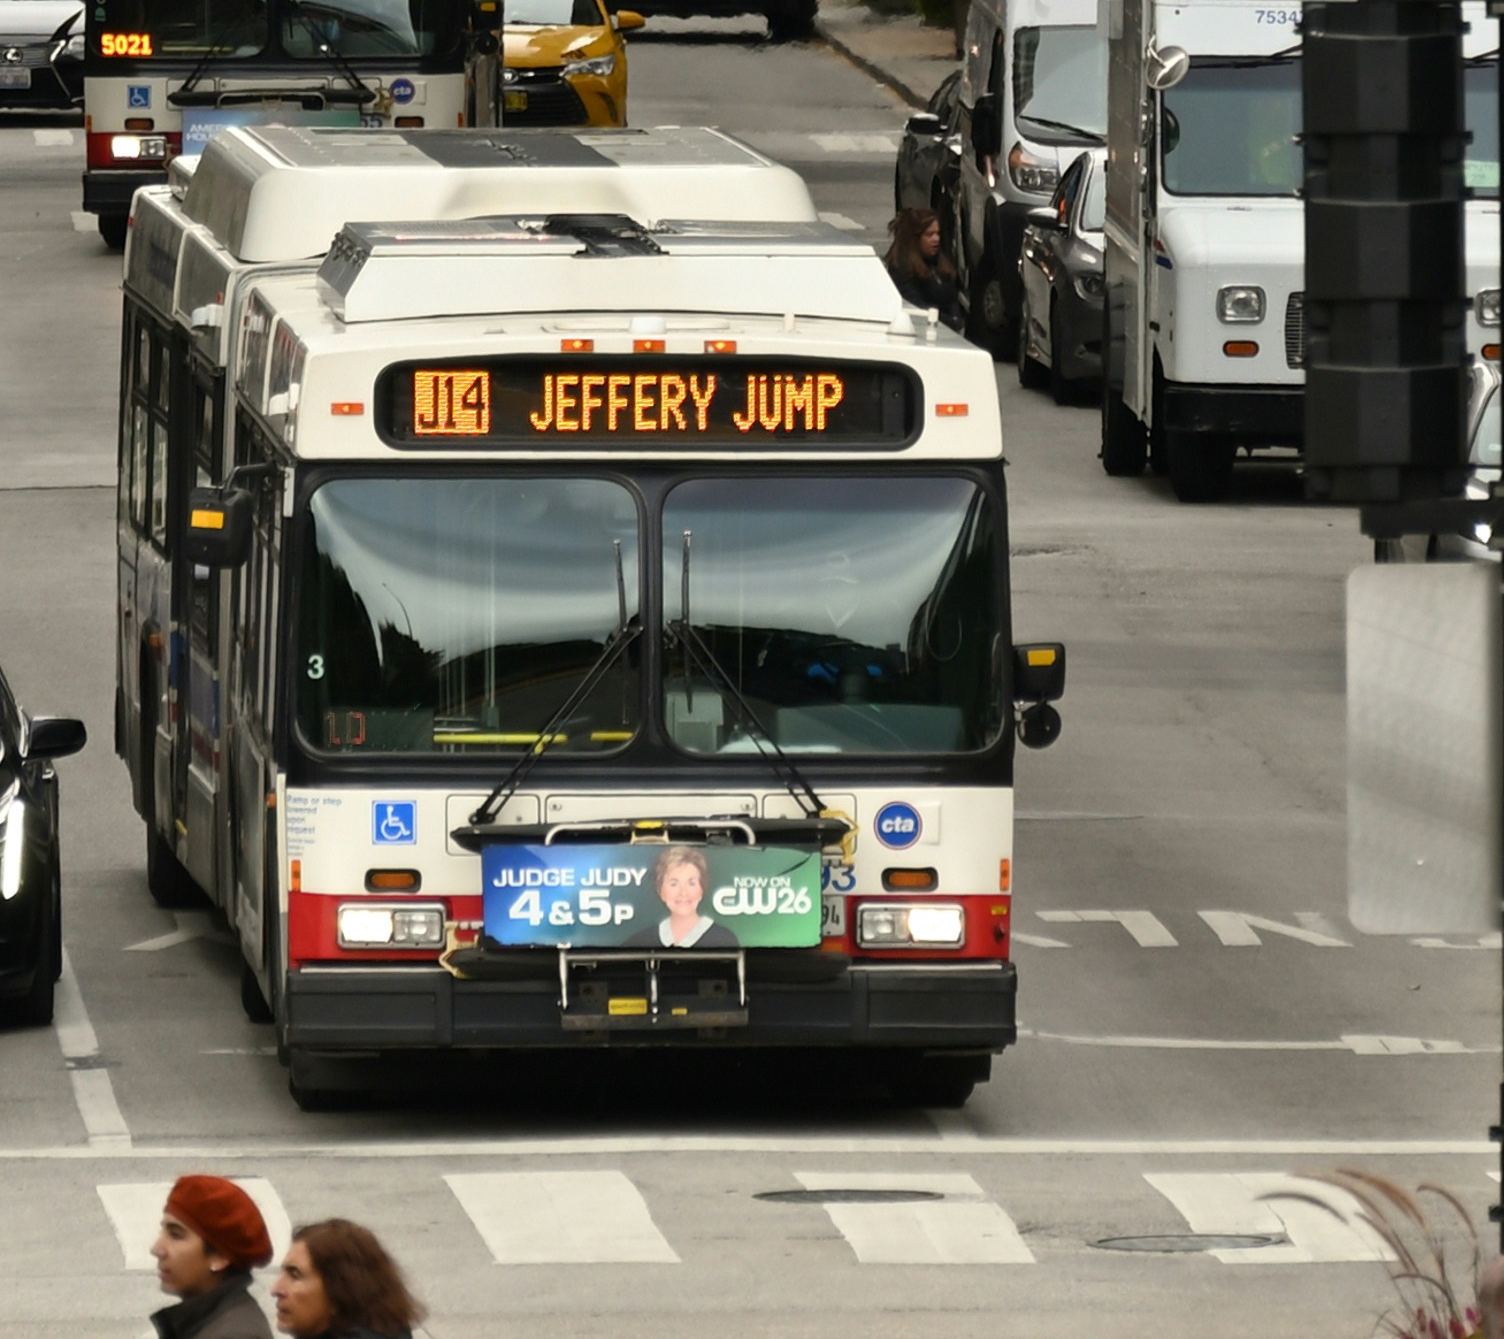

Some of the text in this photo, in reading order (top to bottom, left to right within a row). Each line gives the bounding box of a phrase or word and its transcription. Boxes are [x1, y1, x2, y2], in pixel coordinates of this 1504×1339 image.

[101, 33, 153, 57] 5021
[393, 85, 412, 96] cta
[417, 373, 844, 432] J14 JEFFERY JUMP
[307, 654, 325, 680] 3
[880, 815, 915, 834] cta
[493, 867, 648, 888] JUDGE JUDY
[733, 876, 791, 888] NOW ON
[509, 889, 544, 926] 4
[548, 900, 575, 926] &
